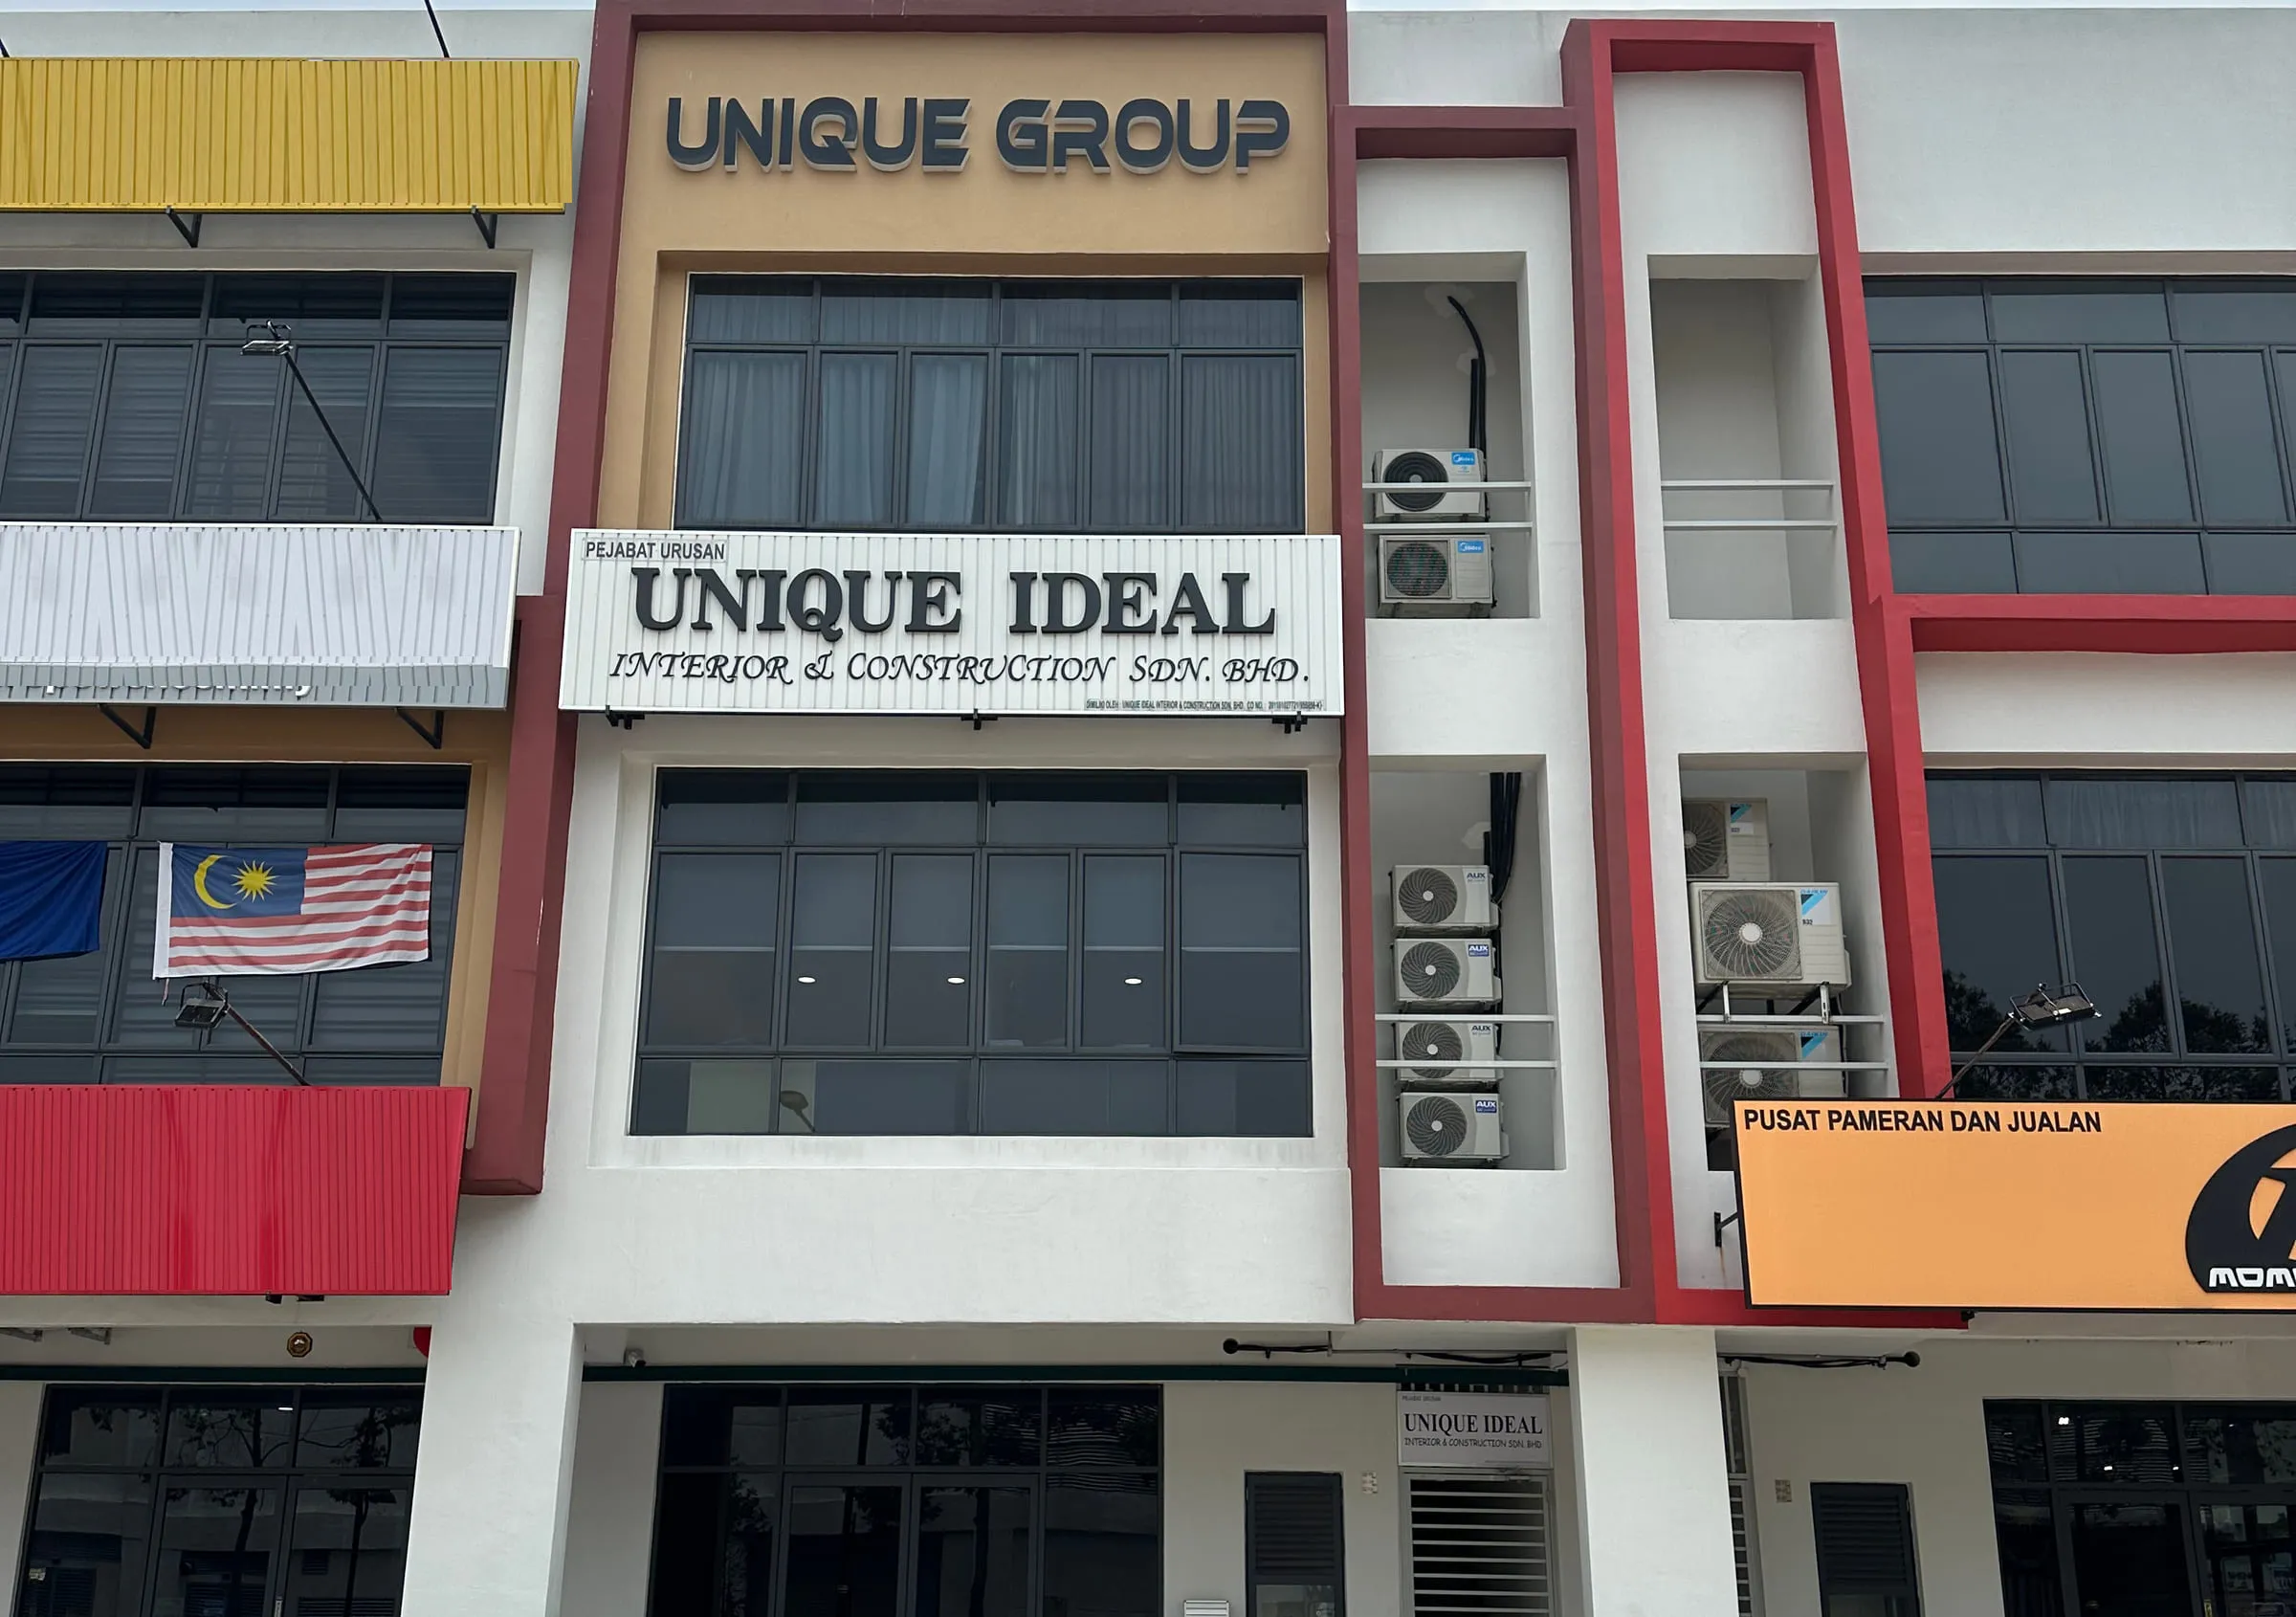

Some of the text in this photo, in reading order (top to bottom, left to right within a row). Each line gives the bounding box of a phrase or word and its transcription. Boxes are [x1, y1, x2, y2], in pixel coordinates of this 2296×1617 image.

[666, 97, 1291, 175] UNIQUE GROUP
[585, 541, 725, 560] PEJABAT URUSAN
[630, 566, 1276, 642] UNIQUE IDEAL
[609, 650, 1311, 685] INTERIOR & CONSTRUCTION SDN. BHD.
[1183, 700, 1221, 710] CONSTRUCTION
[1744, 1109, 2102, 1133] PUSAT PAMERAN DAN JUALAN
[2209, 1267, 2296, 1287] MOM
[1404, 1413, 1543, 1436] UNIQUE IDEAL
[1404, 1437, 1441, 1447] INTERIOR
[1443, 1438, 1447, 1447] &
[1448, 1438, 1507, 1448] CONSTRUCTION
